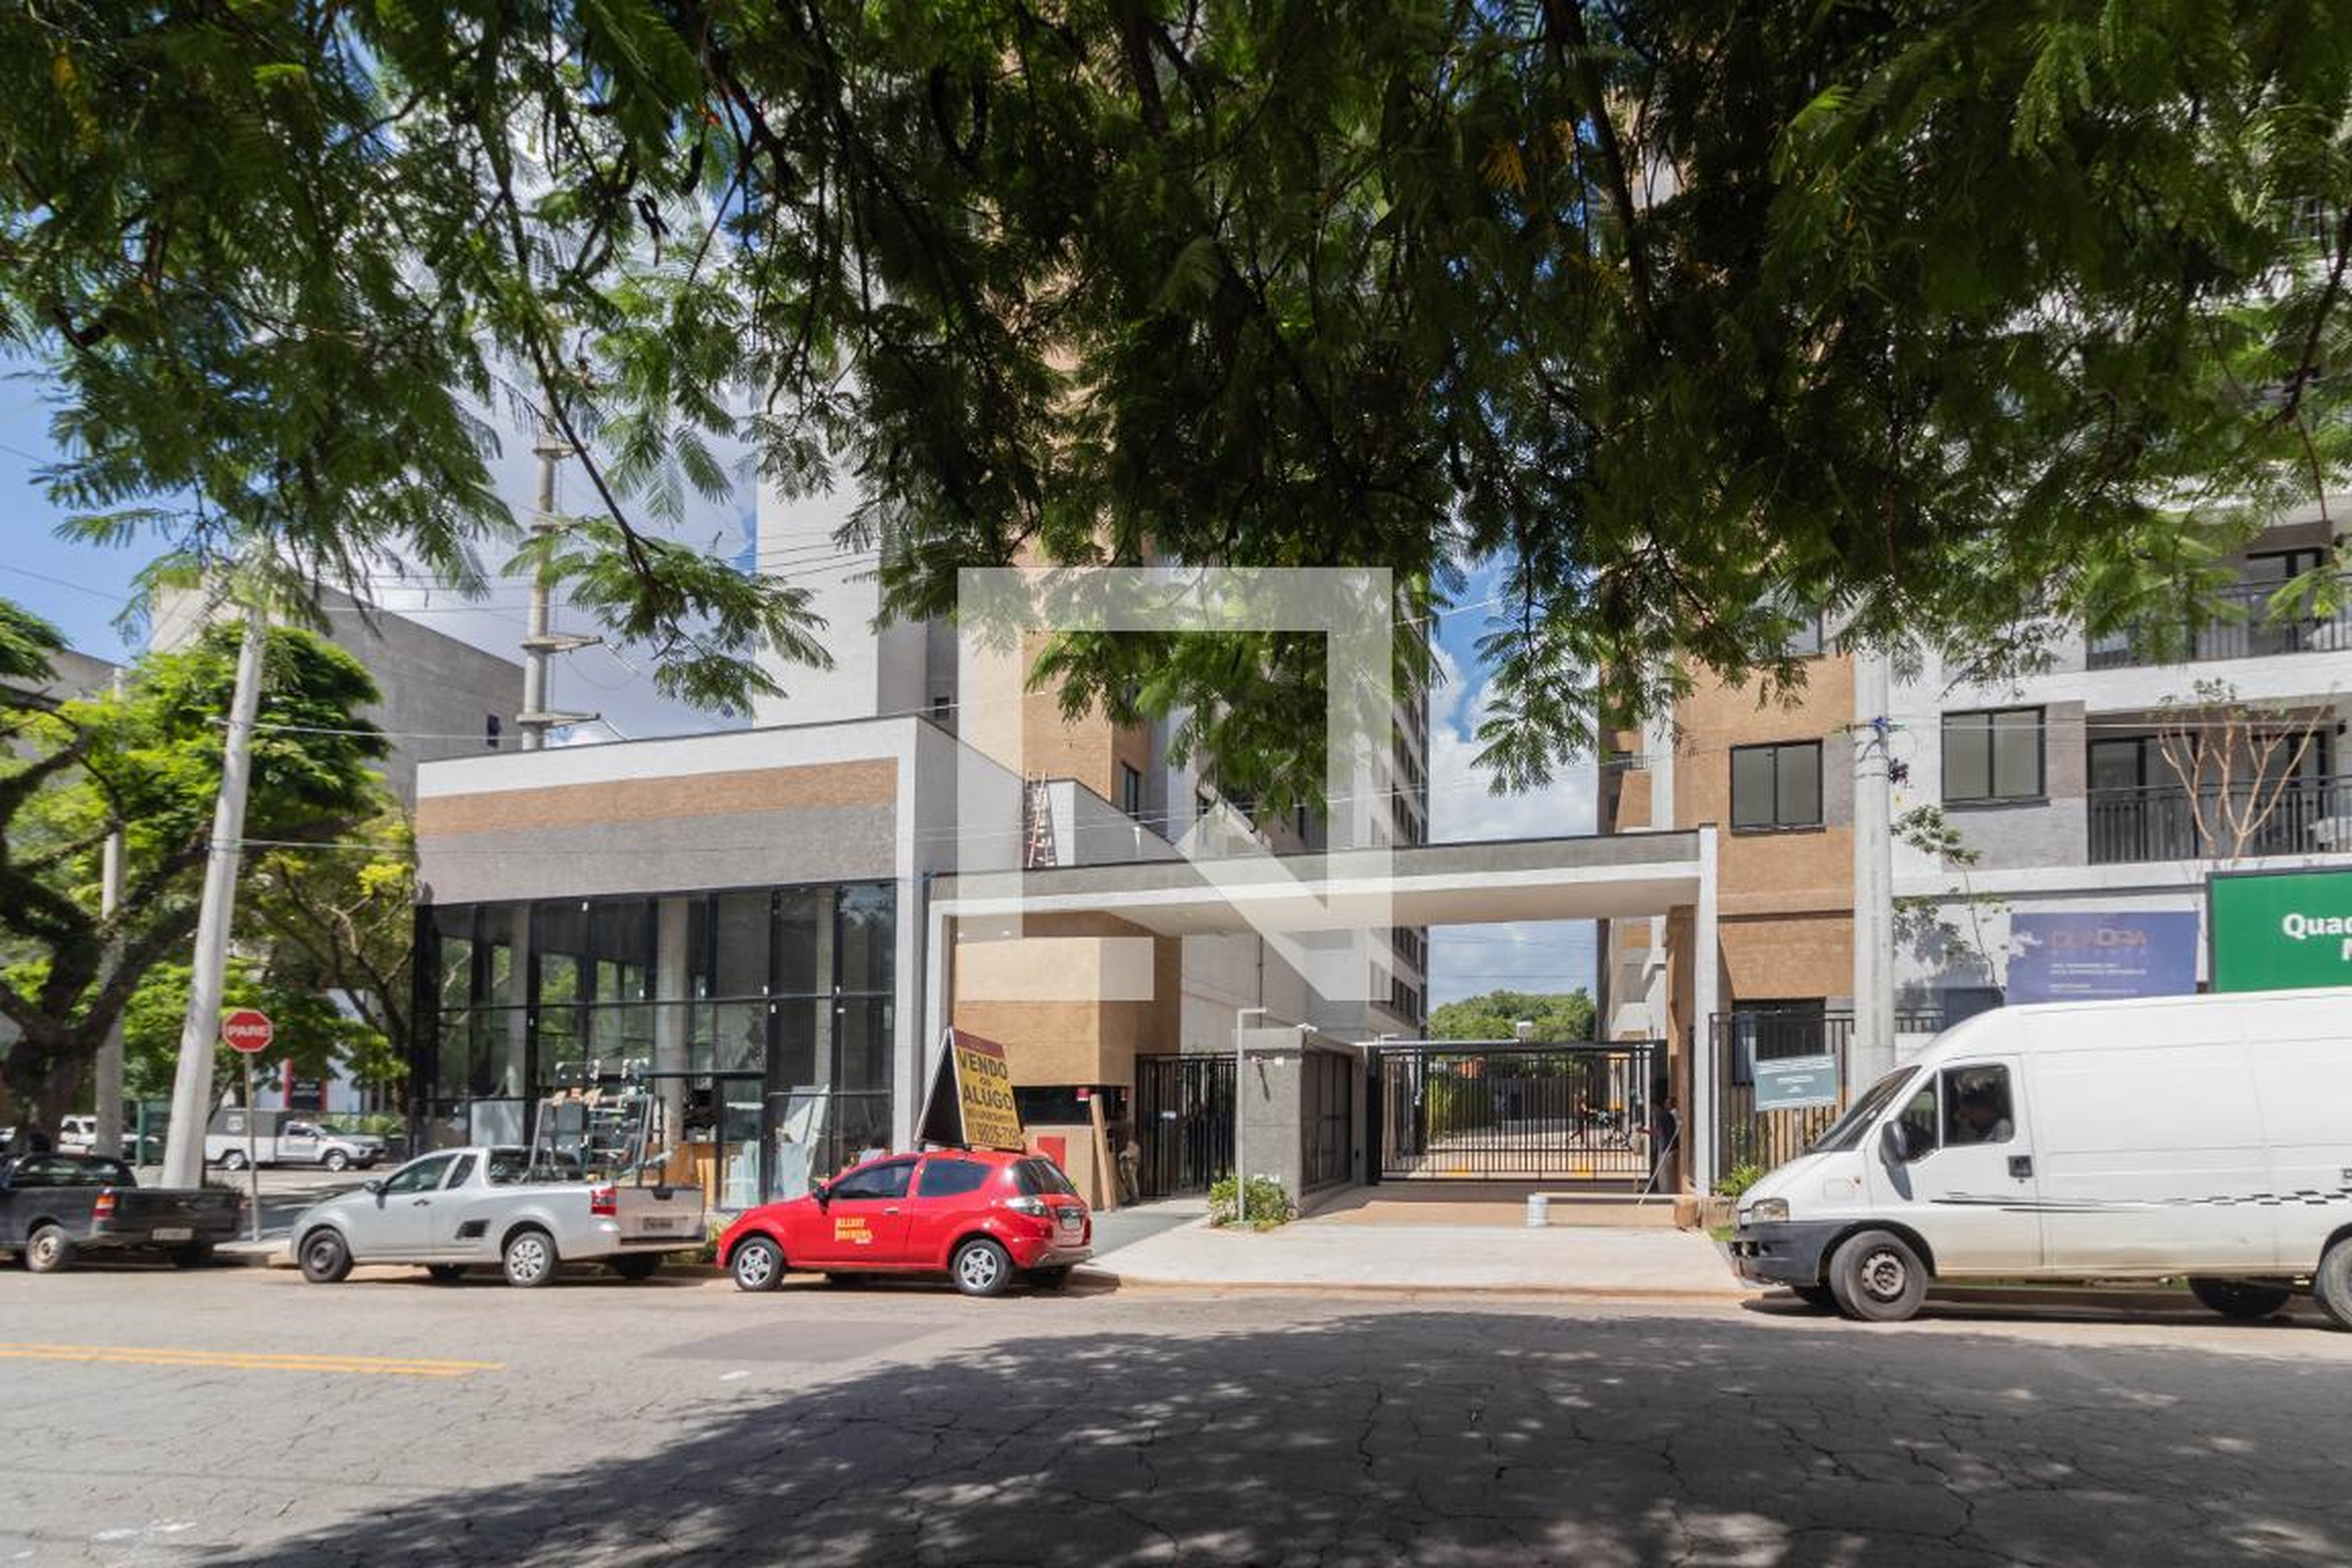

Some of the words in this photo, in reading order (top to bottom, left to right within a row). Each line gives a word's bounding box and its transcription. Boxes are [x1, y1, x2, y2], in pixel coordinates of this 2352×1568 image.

[227, 1025, 268, 1038] PARE
[955, 1048, 1008, 1080] VENDO
[962, 1084, 1013, 1110] ALUGO
